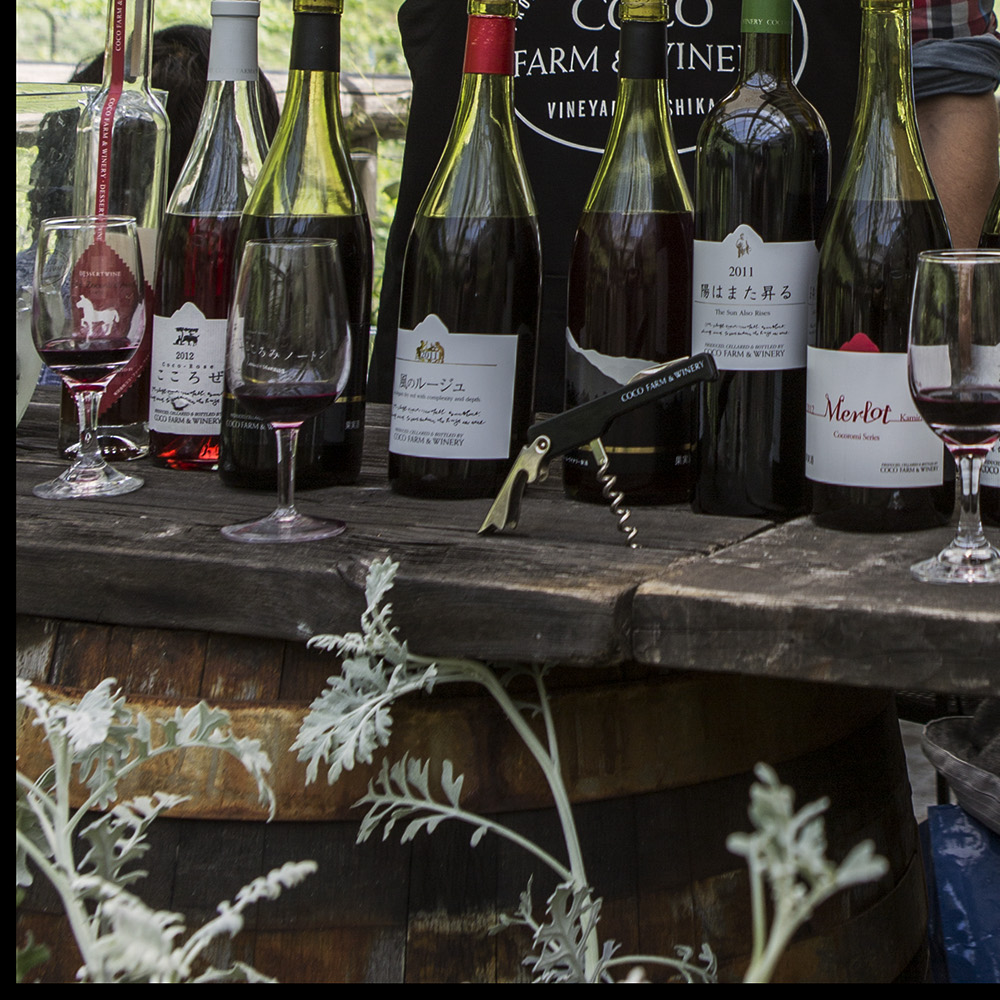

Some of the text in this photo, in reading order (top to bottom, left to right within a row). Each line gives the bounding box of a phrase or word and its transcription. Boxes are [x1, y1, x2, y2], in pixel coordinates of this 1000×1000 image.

[514, 46, 598, 77] FARM
[102, 97, 115, 116] COCO
[102, 118, 112, 139] FARM
[100, 150, 108, 178] WINERY
[729, 266, 754, 277] 2011
[701, 283, 792, 300] 陽はまた昇る
[176, 352, 194, 360] 2012
[724, 350, 744, 358] FARM
[753, 350, 786, 358] WINERY
[621, 360, 705, 402] COCO FARM & WINERY
[825, 393, 892, 425] Merlot
[432, 438, 465, 446] WINERY
